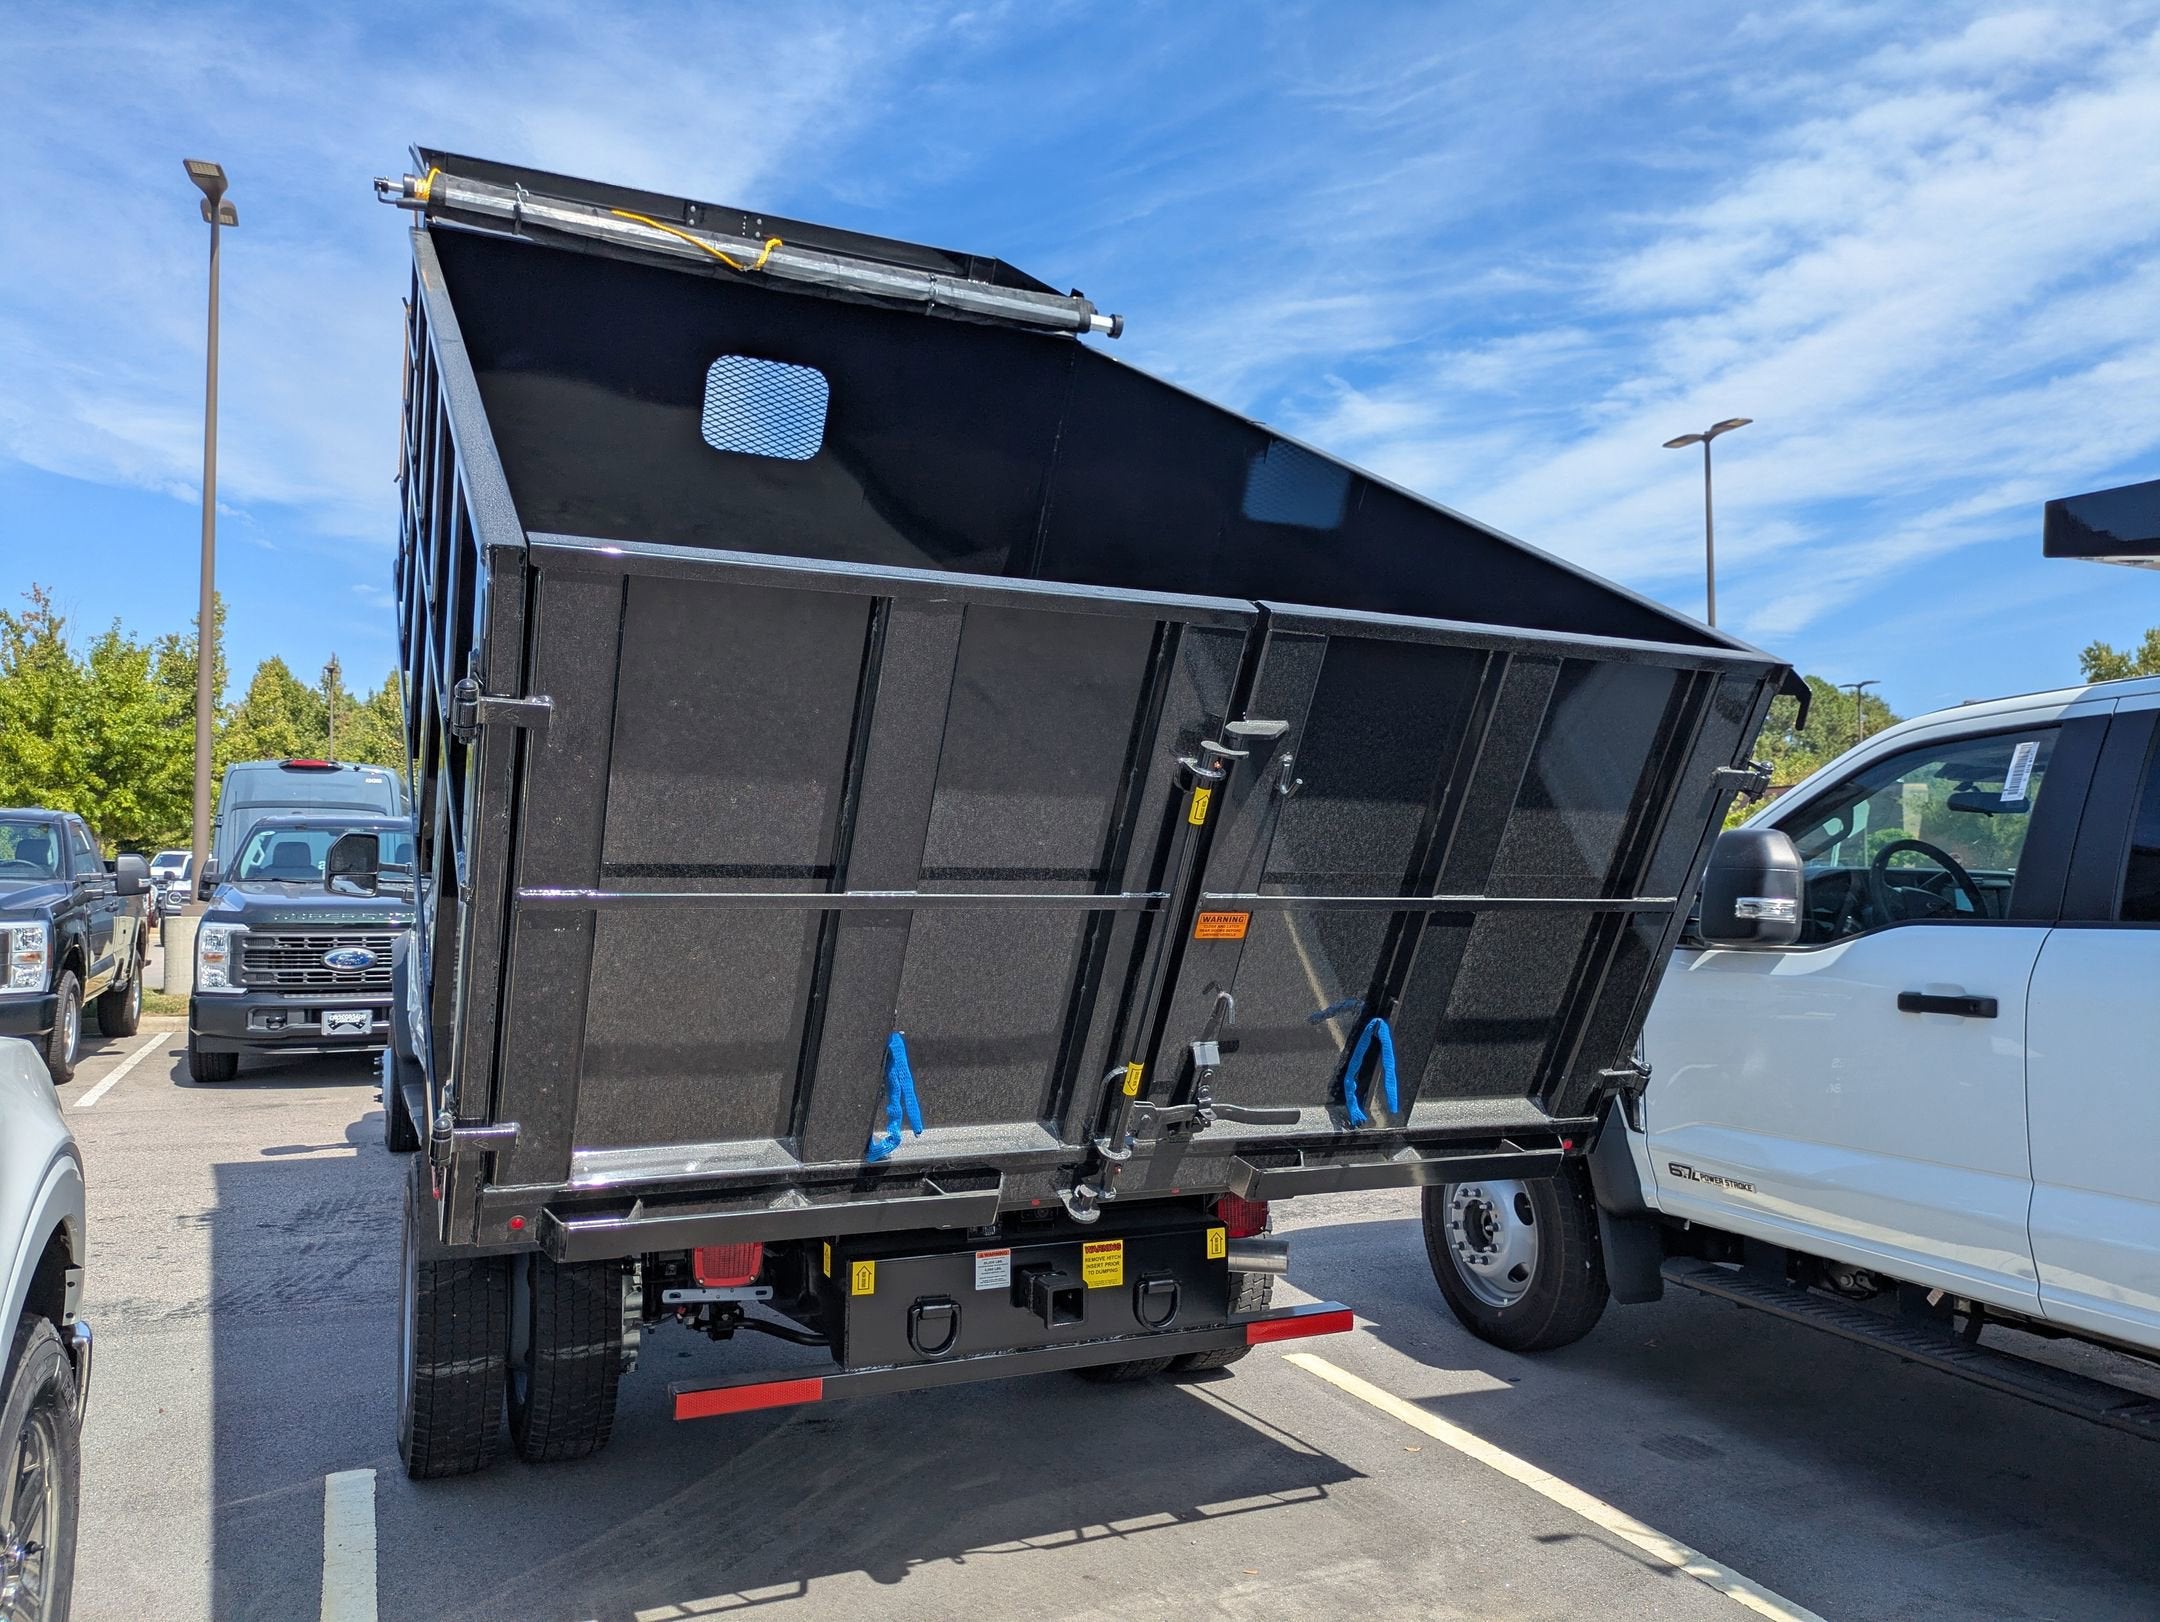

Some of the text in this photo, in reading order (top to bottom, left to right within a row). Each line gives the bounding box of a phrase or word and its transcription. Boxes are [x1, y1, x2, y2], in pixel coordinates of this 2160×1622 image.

[335, 953, 364, 965] Ford
[1668, 1162, 1753, 1193] 6.7L POWER STROKE
[1085, 1243, 1121, 1254] WARNING
[1095, 1267, 1119, 1275] DUMPING
